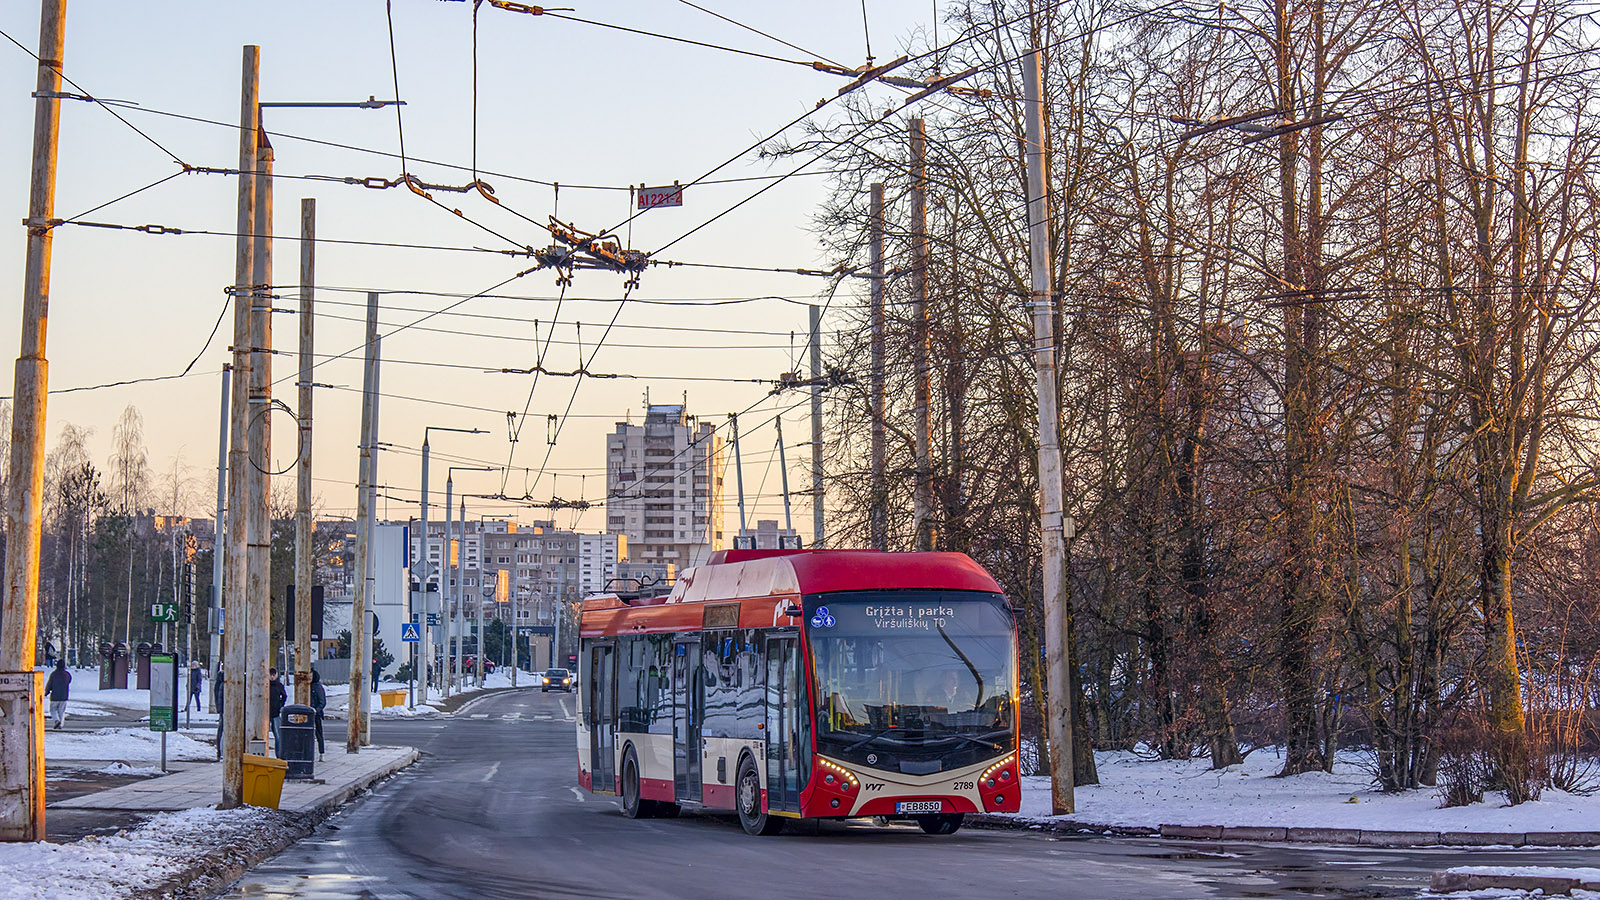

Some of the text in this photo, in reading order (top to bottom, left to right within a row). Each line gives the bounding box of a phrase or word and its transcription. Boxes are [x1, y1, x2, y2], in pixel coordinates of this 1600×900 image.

[865, 606, 954, 618] Grįžta į parką
[875, 618, 928, 630] Viršuliškių
[865, 783, 885, 791] VVT
[953, 782, 974, 790] 2789
[906, 802, 940, 811] EB8650
